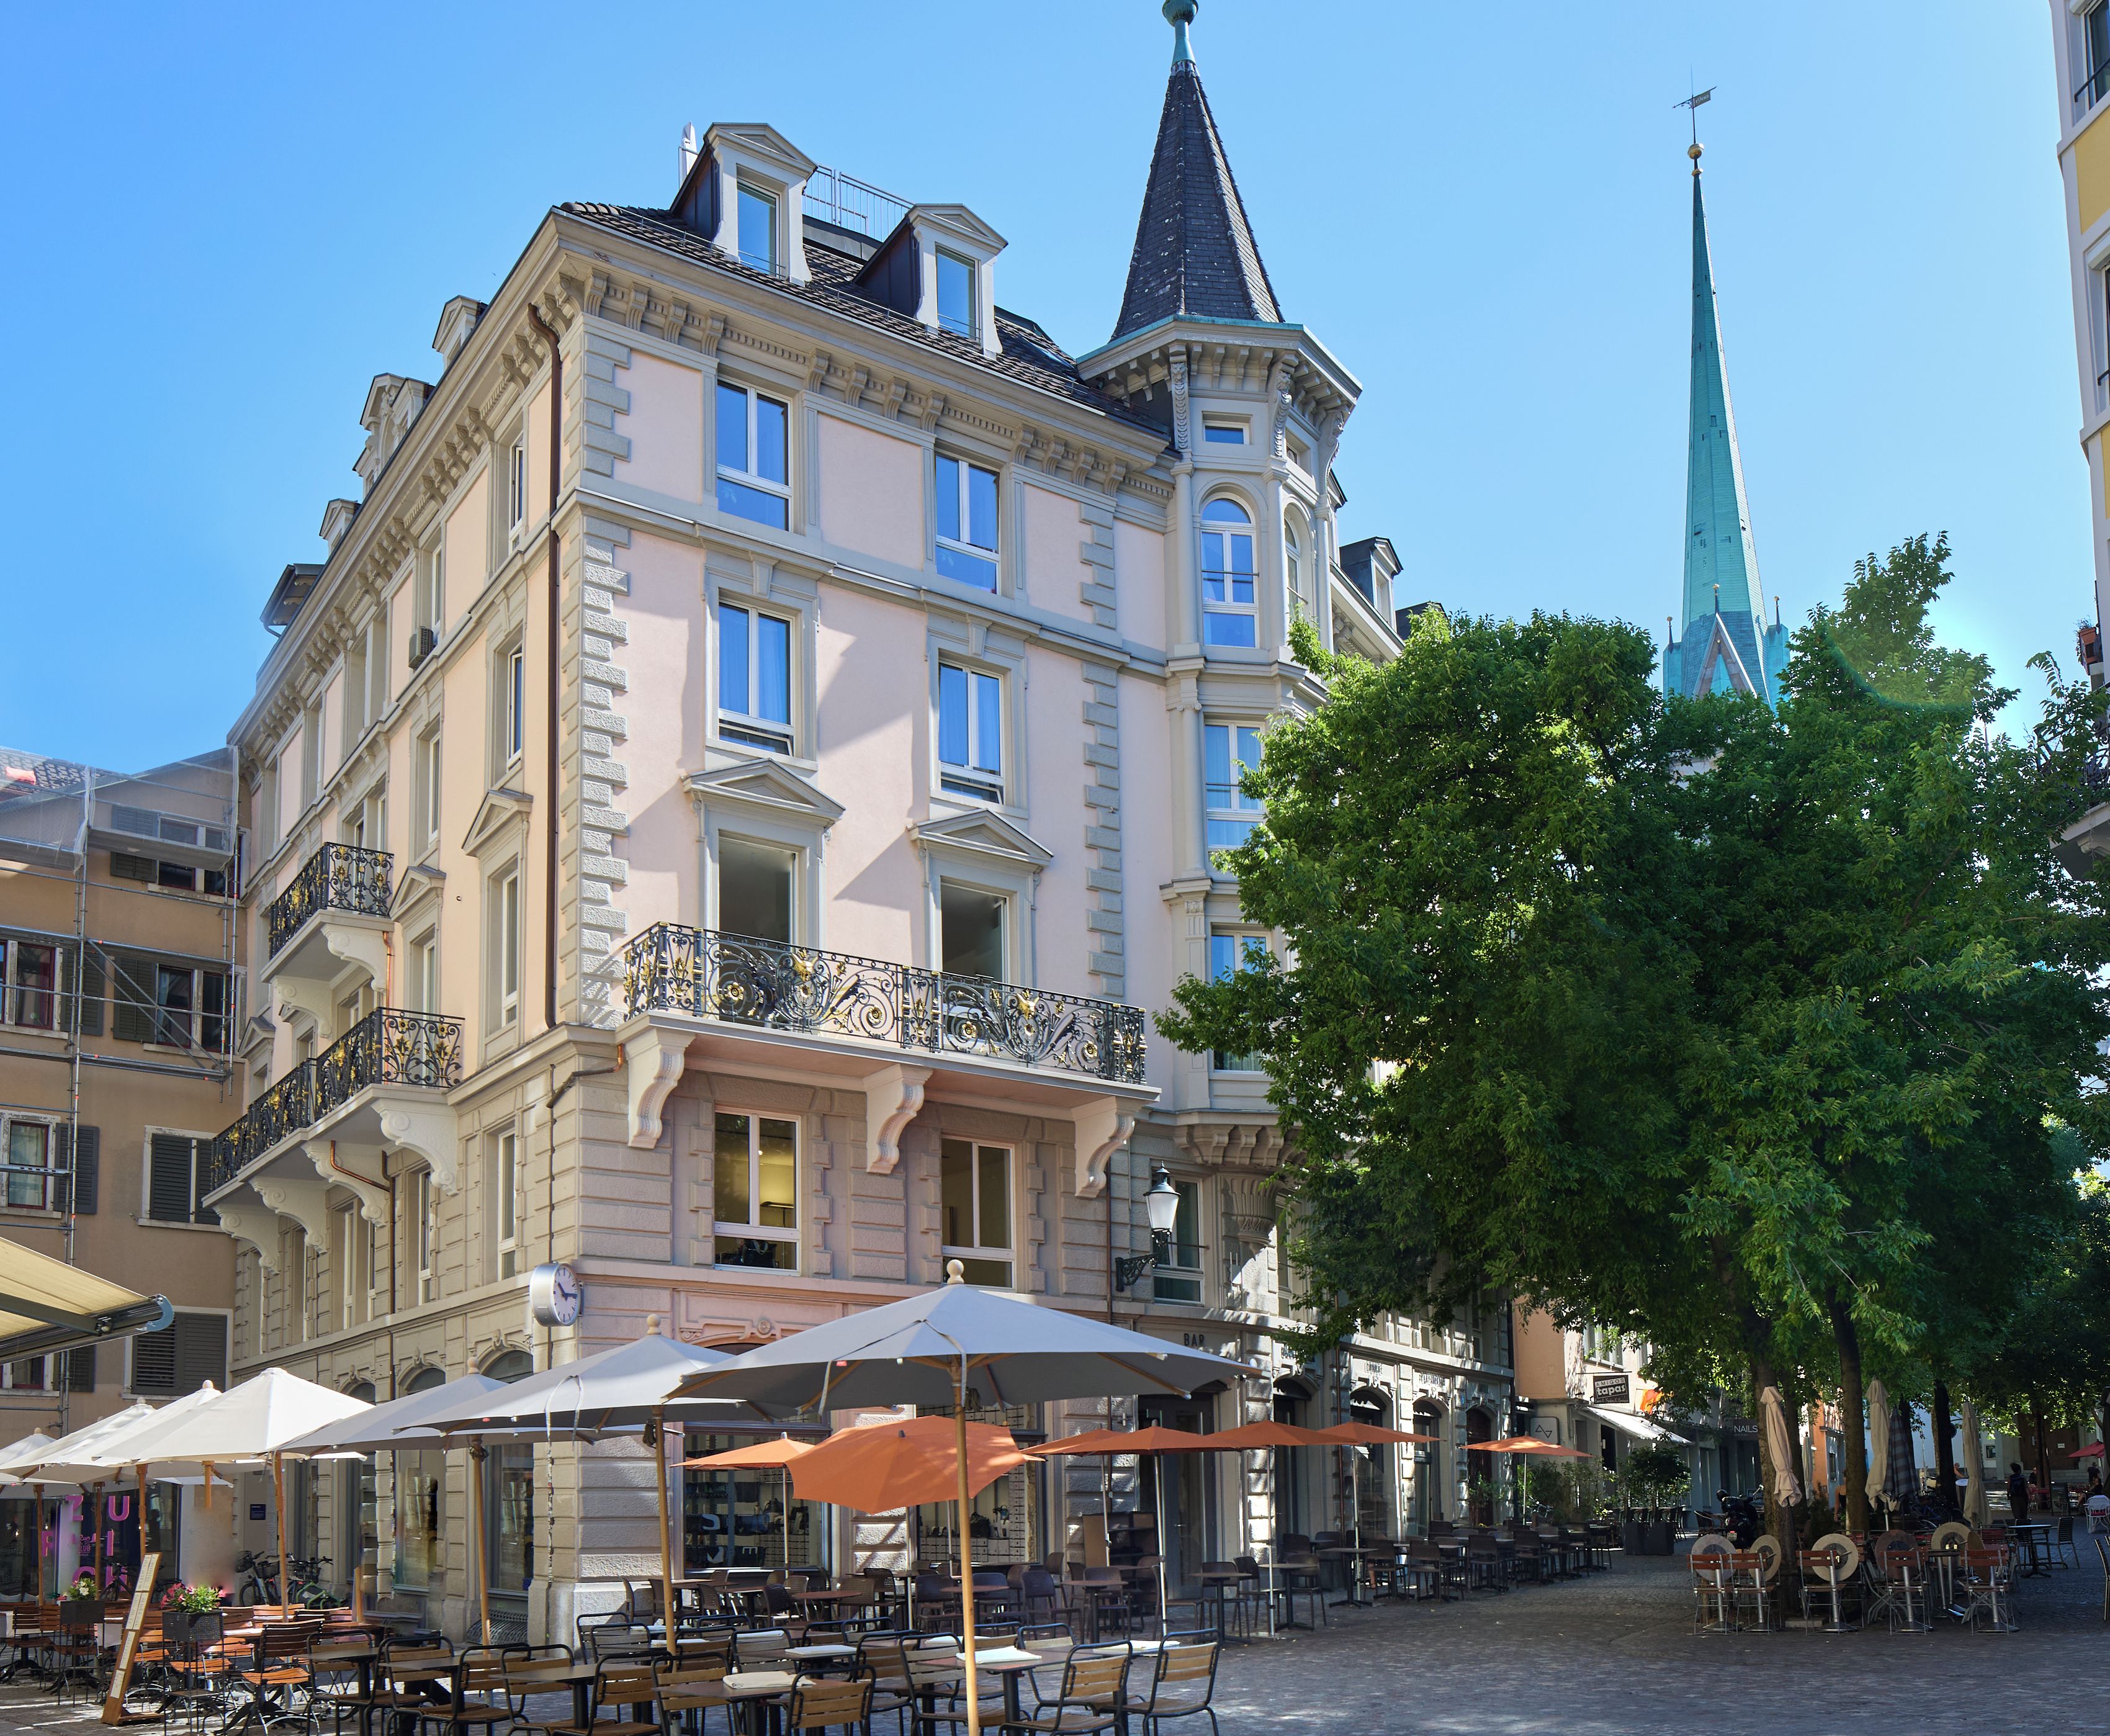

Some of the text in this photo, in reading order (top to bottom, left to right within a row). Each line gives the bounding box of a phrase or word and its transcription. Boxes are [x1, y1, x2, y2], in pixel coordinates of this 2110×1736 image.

[1596, 1378, 1625, 1387] AMIGOS
[1597, 1385, 1626, 1396] tapas
[1734, 1425, 1758, 1433] NAILS
